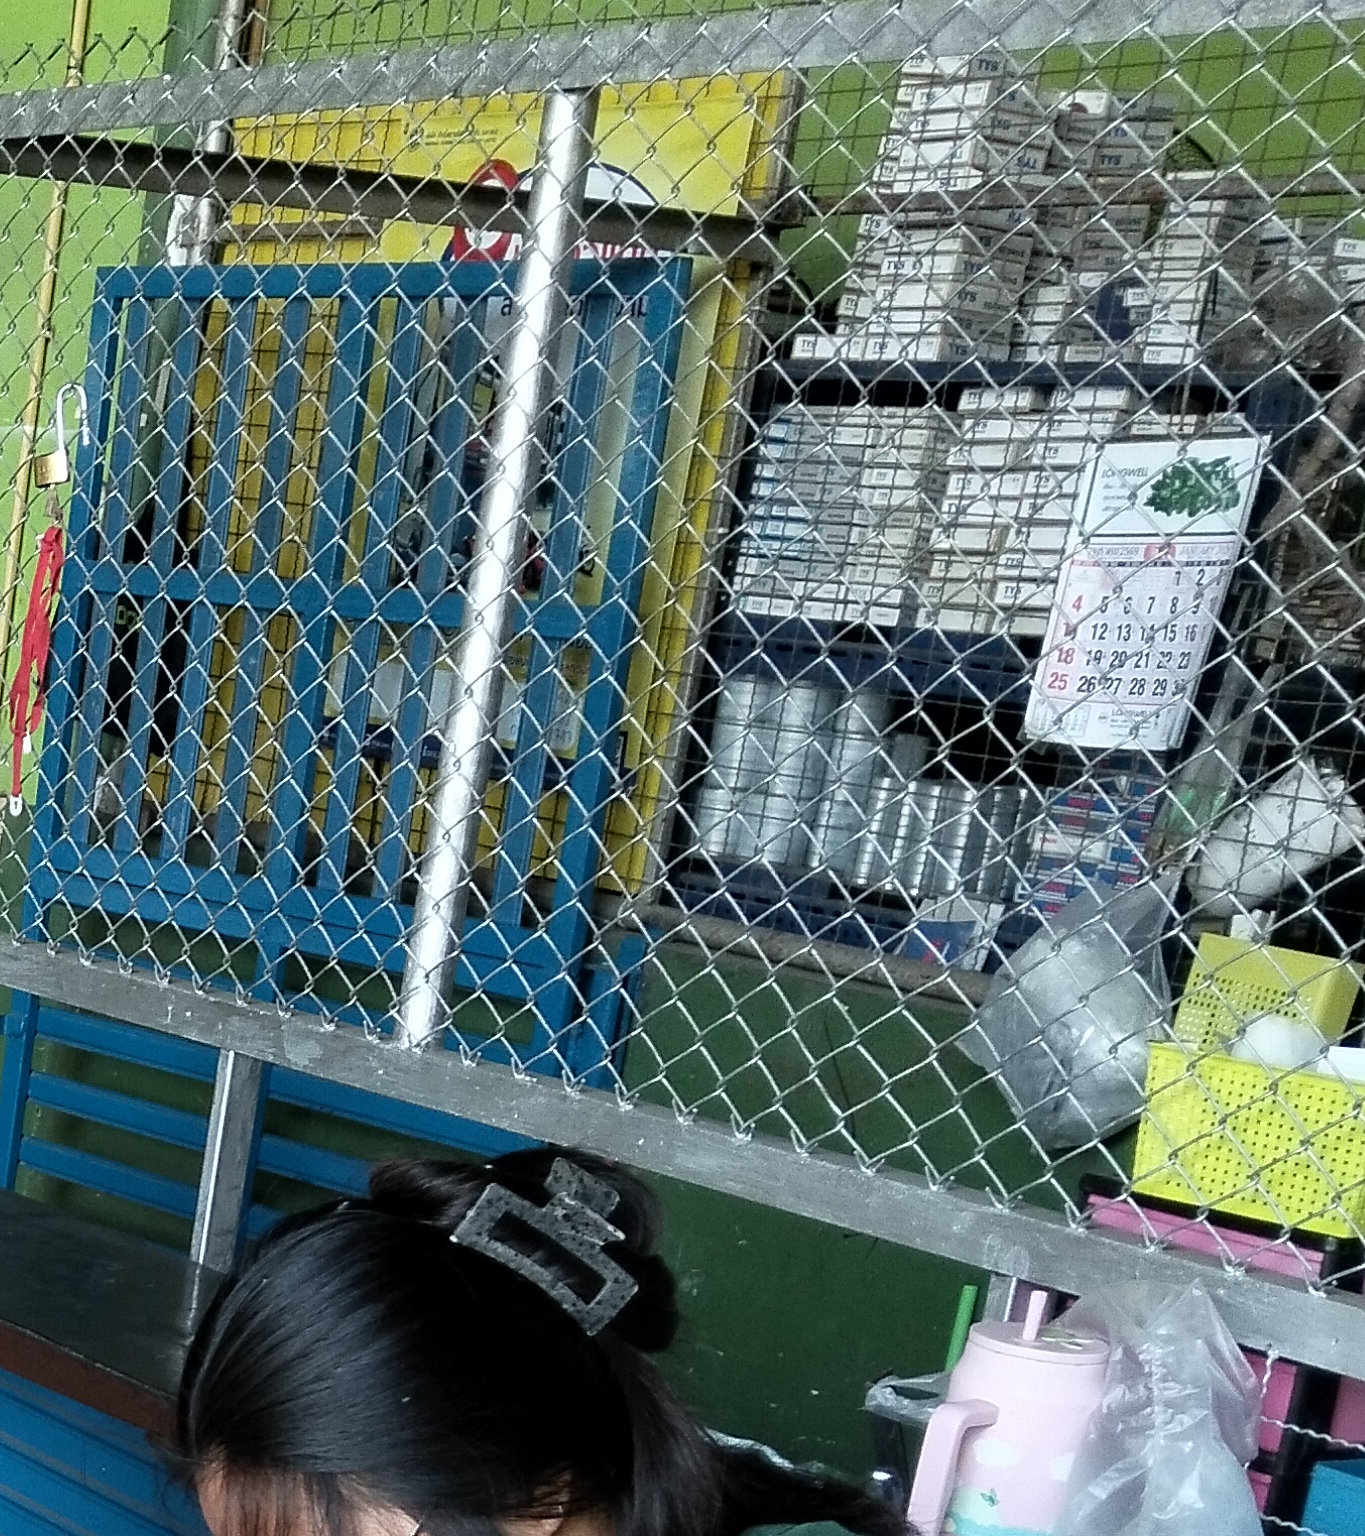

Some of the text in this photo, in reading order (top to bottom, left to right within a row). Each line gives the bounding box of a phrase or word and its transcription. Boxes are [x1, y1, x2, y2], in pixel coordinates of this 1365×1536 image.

[887, 260, 905, 270] TYS
[873, 340, 889, 350] TYS
[1034, 474, 1050, 485] TYS
[1102, 467, 1149, 478] LOGWELL
[1196, 569, 1206, 586] 2
[1004, 586, 1022, 596] TYS
[1072, 595, 1083, 612] 4
[1100, 596, 1110, 614] 5
[1123, 596, 1133, 614] 6
[1147, 596, 1155, 614] 7
[1170, 596, 1180, 614] 8
[1091, 623, 1109, 640] 12
[1117, 623, 1132, 642] 13
[1164, 624, 1177, 642] 15
[1185, 624, 1198, 642] 16
[1056, 647, 1075, 665] 18
[1109, 651, 1128, 669] 20
[1134, 652, 1150, 669] 21
[1047, 672, 1069, 690] 25
[1077, 675, 1097, 693] 26
[1105, 677, 1122, 695] 27
[1129, 678, 1147, 696] 28
[1152, 678, 1168, 696] 29
